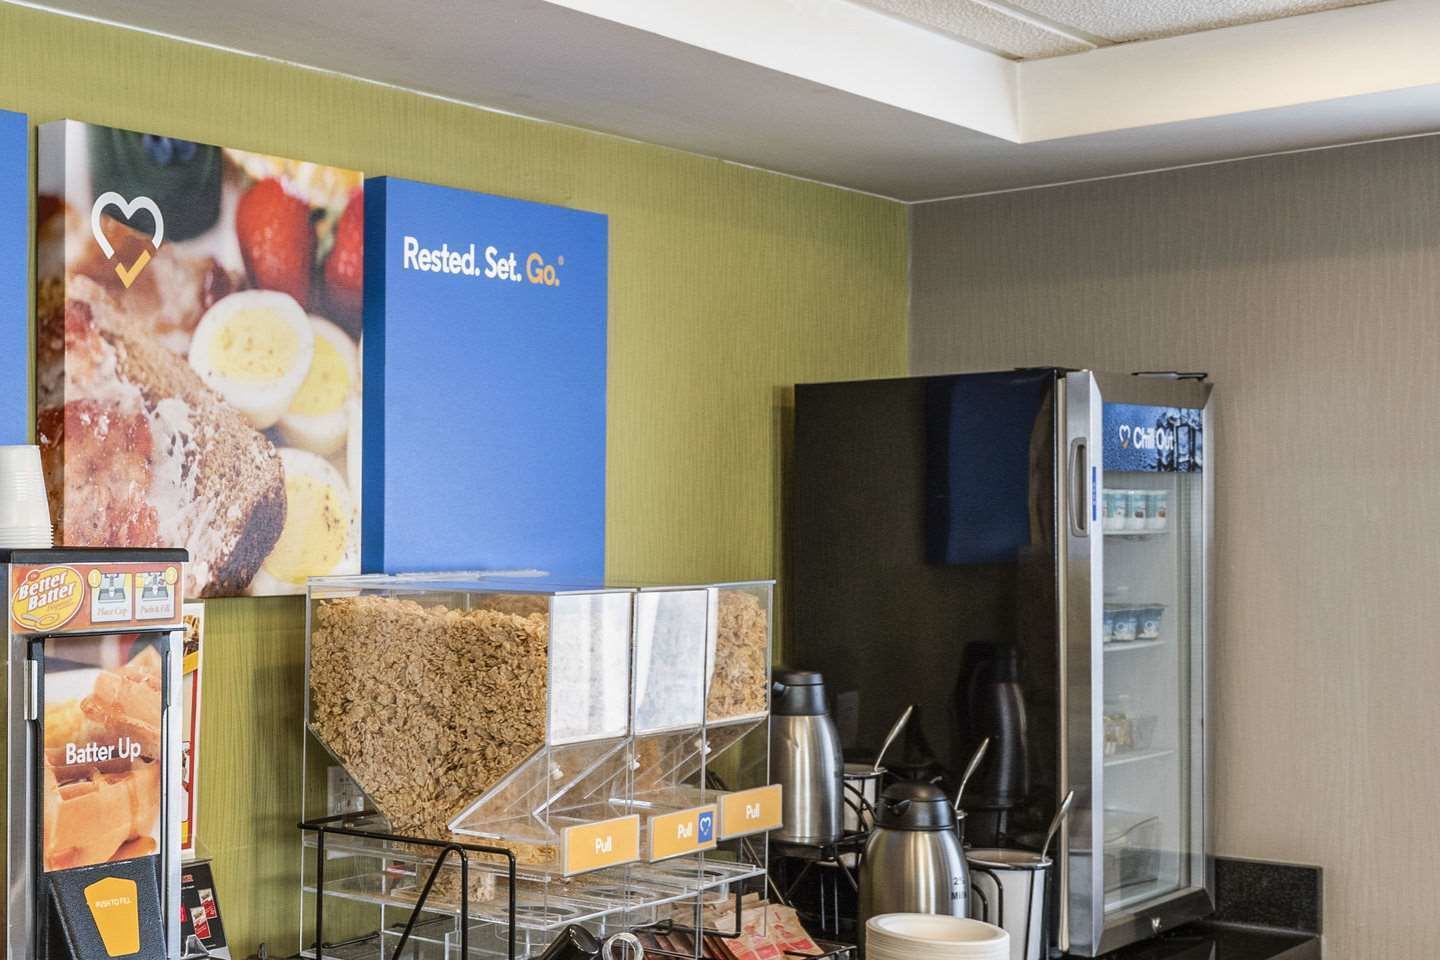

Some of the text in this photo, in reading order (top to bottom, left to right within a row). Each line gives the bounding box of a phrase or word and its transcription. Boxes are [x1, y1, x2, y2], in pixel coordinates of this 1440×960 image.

[403, 235, 481, 277] Rested.
[484, 246, 522, 283] Set.
[1133, 426, 1174, 450] Chill Out
[18, 572, 67, 601] Better
[27, 583, 75, 611] Batter
[65, 736, 142, 765] Batter Up
[745, 803, 761, 820] Pull
[677, 823, 693, 840] Pull
[595, 835, 612, 855] Pull
